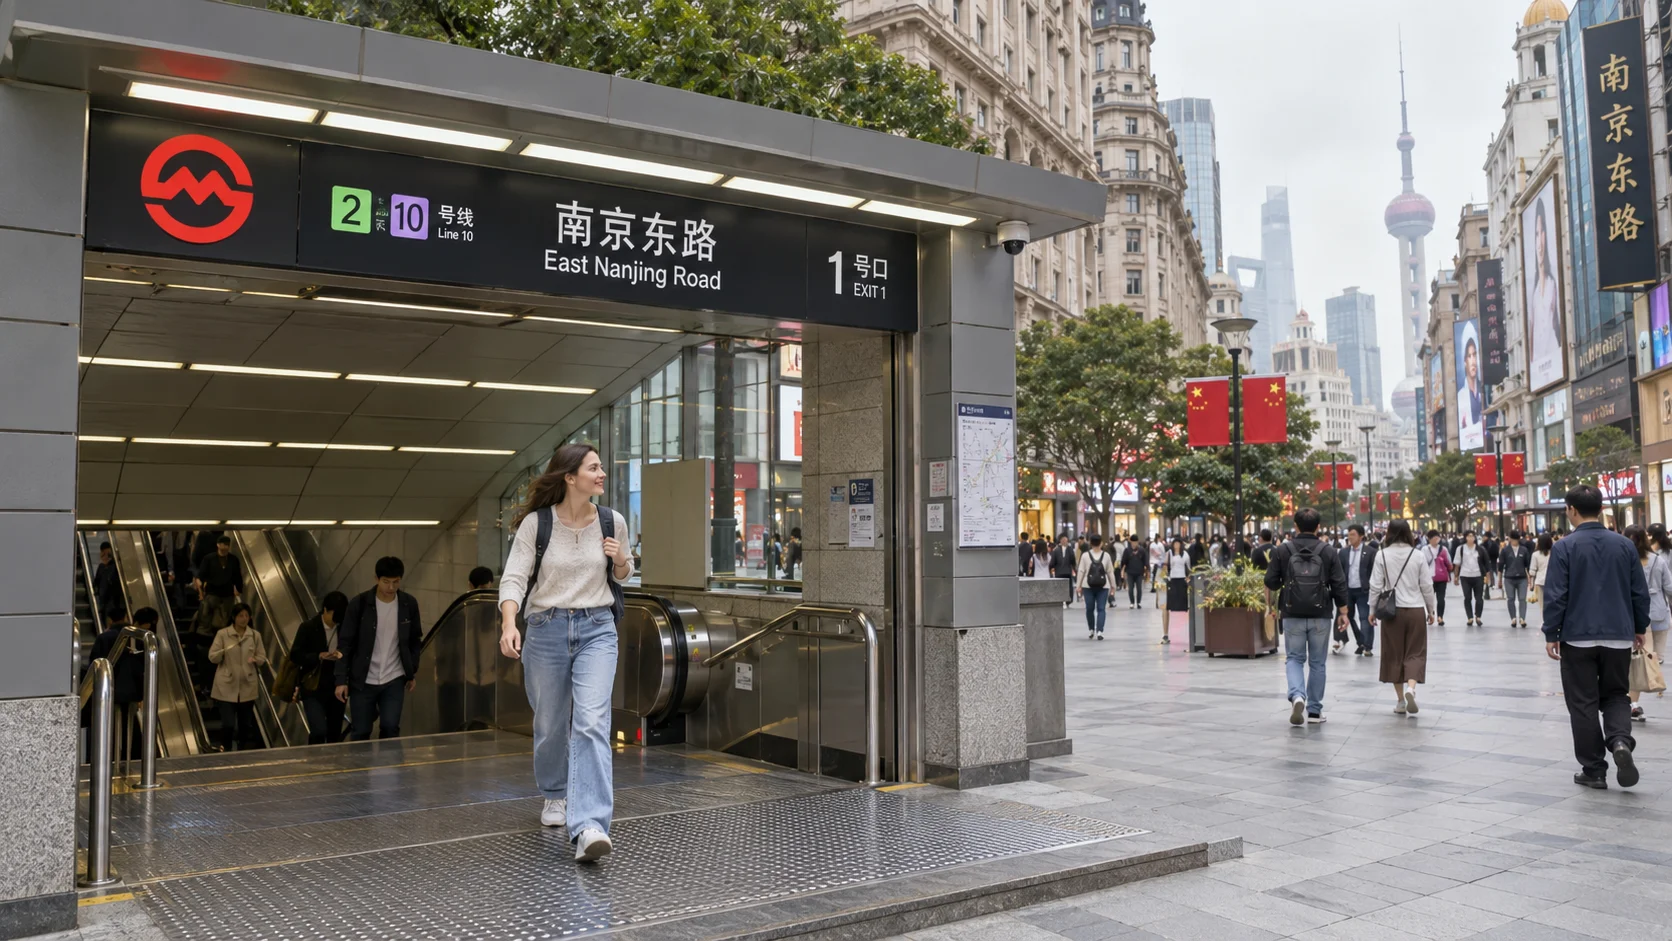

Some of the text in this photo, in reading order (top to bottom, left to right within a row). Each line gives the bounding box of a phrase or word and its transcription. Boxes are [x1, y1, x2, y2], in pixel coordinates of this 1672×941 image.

[1600, 54, 1645, 241] 南京东路
[341, 195, 361, 226] 2
[394, 201, 424, 232] 10
[438, 204, 474, 228] 号线
[438, 227, 474, 242] Line 10
[556, 200, 717, 262] 南京东路
[544, 249, 721, 290] East Nanjing Road
[828, 250, 888, 295] 1 号口
[854, 282, 886, 300] EXIT 1
